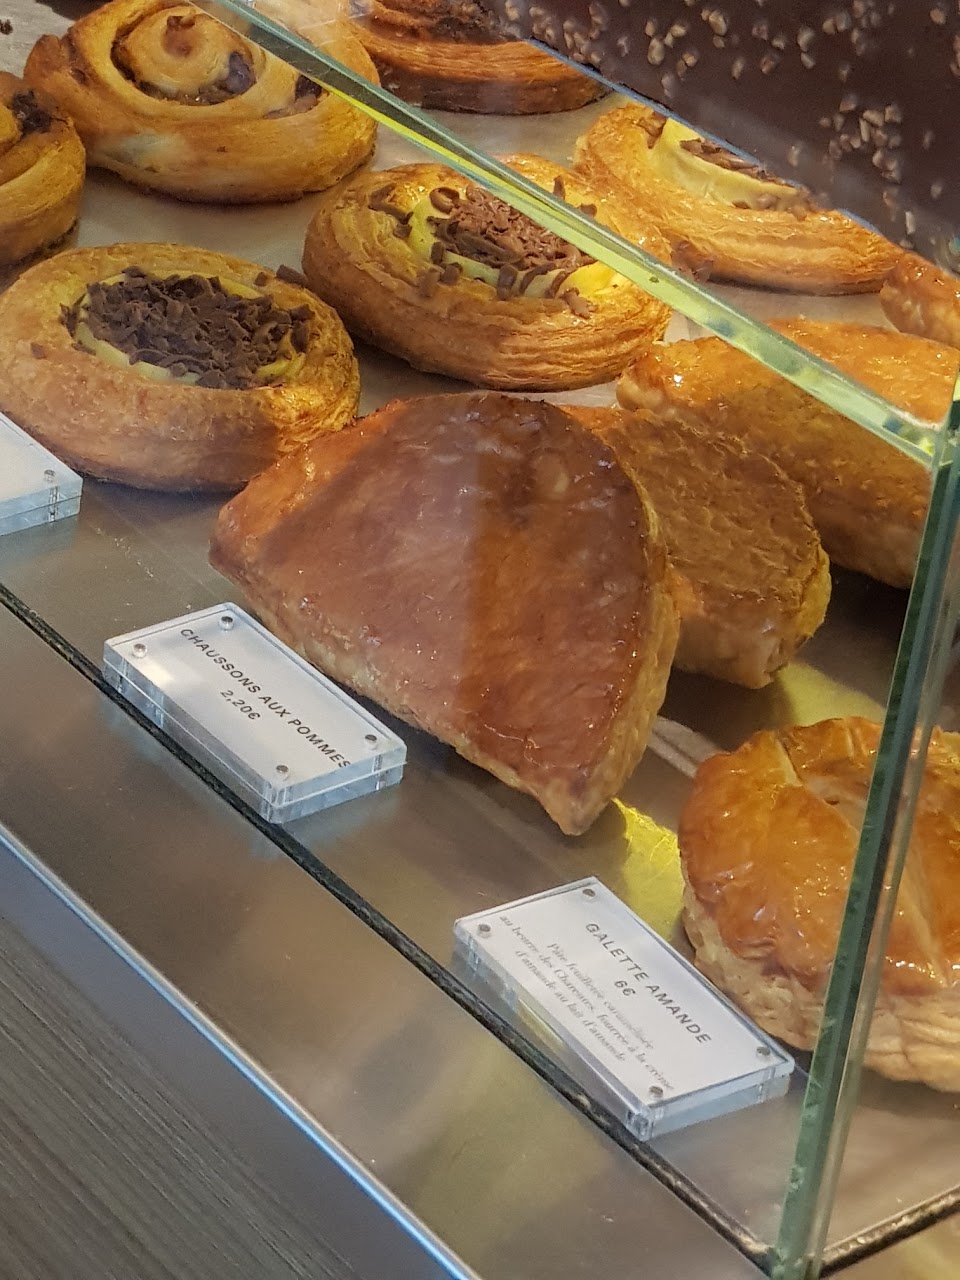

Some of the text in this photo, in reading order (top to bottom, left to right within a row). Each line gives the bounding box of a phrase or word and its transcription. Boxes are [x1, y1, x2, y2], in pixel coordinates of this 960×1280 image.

[180, 628, 352, 769] CHAUSSONS AUX POMMES
[585, 922, 713, 1044] GALETTE AMANDE
